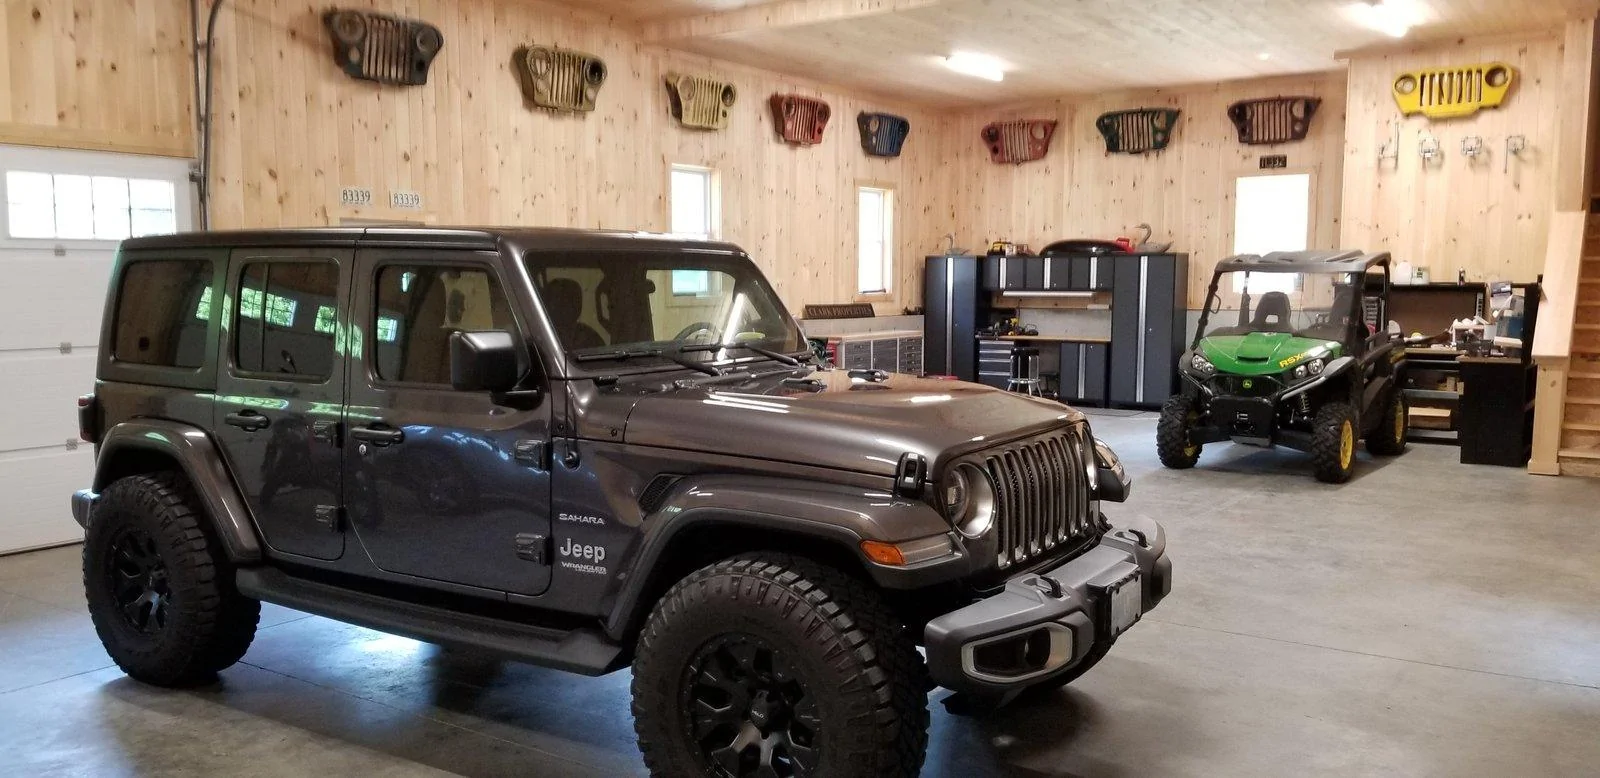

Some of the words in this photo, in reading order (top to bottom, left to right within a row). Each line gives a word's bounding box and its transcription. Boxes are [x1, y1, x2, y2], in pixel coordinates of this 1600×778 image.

[342, 189, 371, 202] 83339
[393, 193, 420, 205] 83339
[808, 307, 832, 316] CLARK
[832, 306, 872, 316] PROPERTIES
[559, 513, 605, 525] SAHARA
[560, 537, 606, 563] Jeep
[561, 561, 607, 572] WRANGLER
